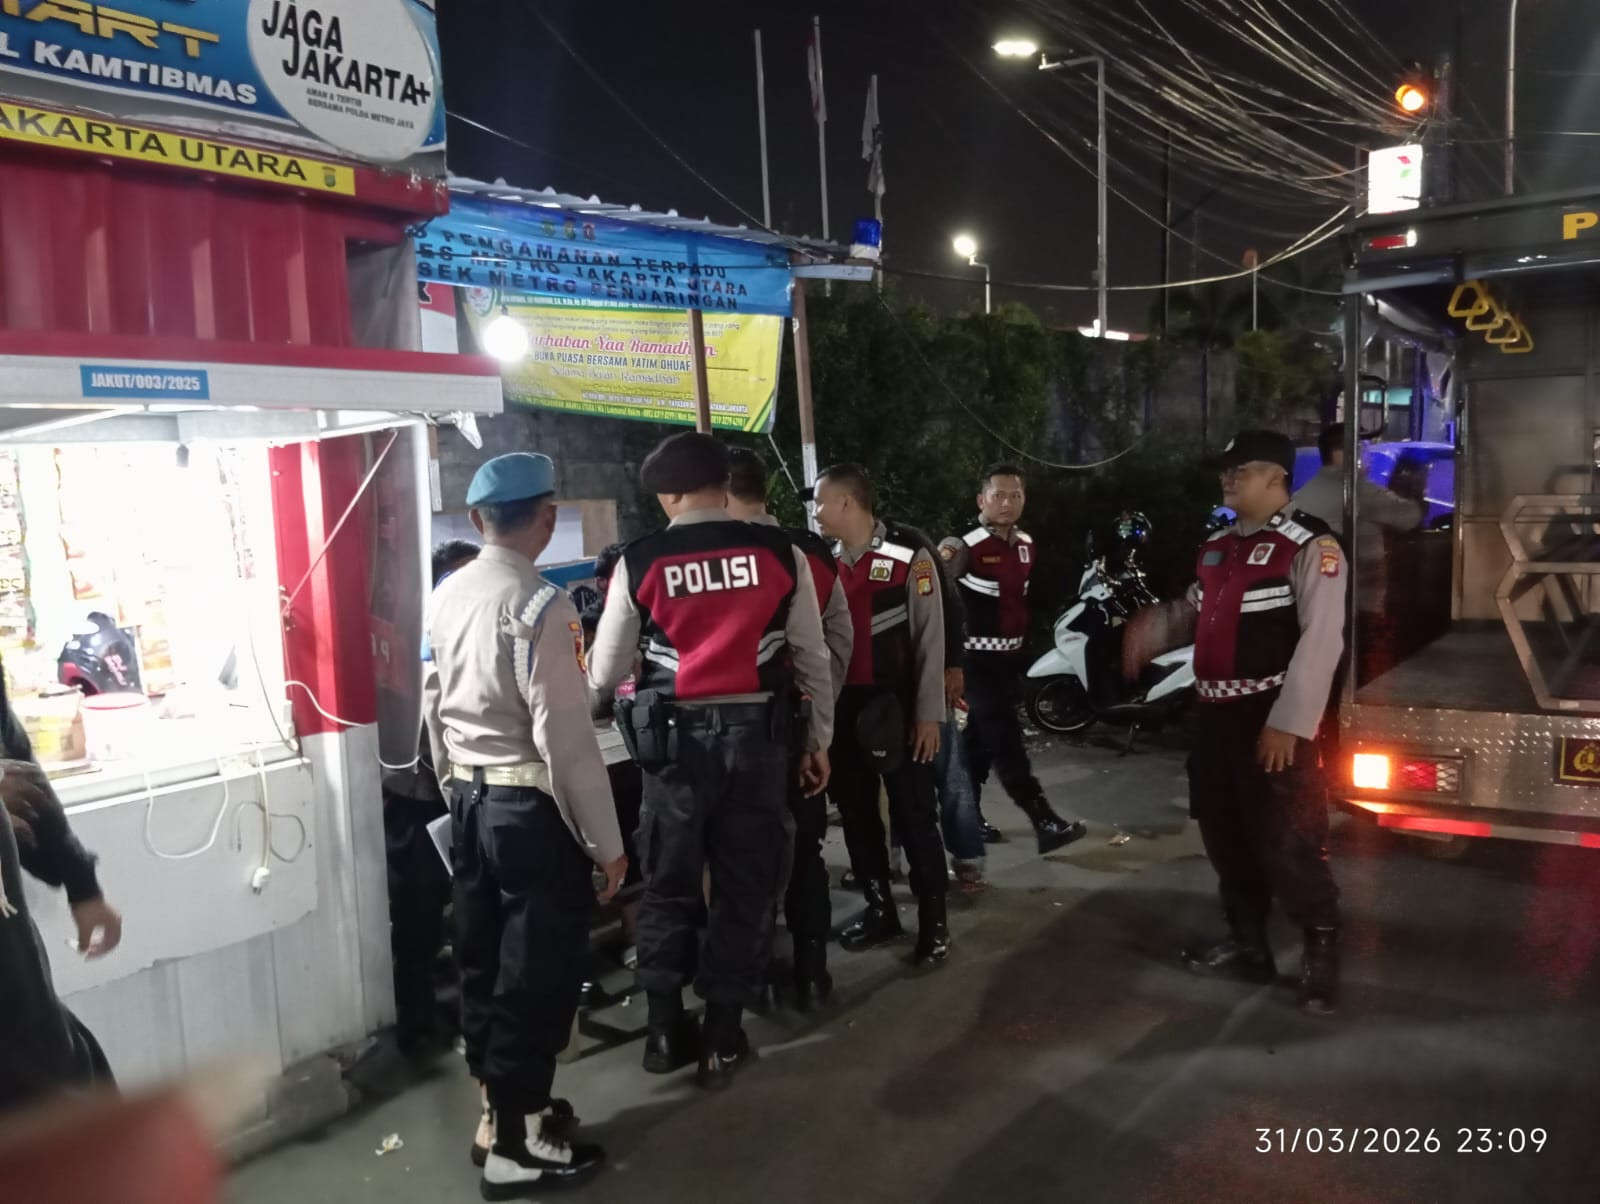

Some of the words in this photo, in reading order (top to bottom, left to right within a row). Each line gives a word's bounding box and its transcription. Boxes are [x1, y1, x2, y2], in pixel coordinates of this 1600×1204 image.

[262, 0, 343, 53] JAGA
[34, 40, 257, 105] KAMTIBMAS
[307, 88, 328, 98] AMAN
[308, 98, 343, 113] BERSAMA
[345, 107, 369, 119] POLDA
[371, 113, 395, 125] METRO
[179, 138, 307, 181] UTARA
[1563, 212, 1598, 240] P
[441, 230, 620, 267] PENGAMANAN
[632, 256, 726, 279] TERPADU
[471, 250, 561, 274] METRO
[575, 266, 676, 289] JAKARTA
[687, 278, 748, 297] UTARA
[489, 270, 577, 293] METRO
[591, 282, 738, 310] PENJARINGAN
[557, 352, 584, 364] PUASA
[587, 354, 628, 367] BERSAMA
[631, 357, 657, 369] YATIM
[596, 335, 625, 352] Yaa
[630, 339, 716, 356] Ramadhn
[91, 371, 201, 391] JAKUT/003/2025
[664, 554, 759, 598] POLISI
